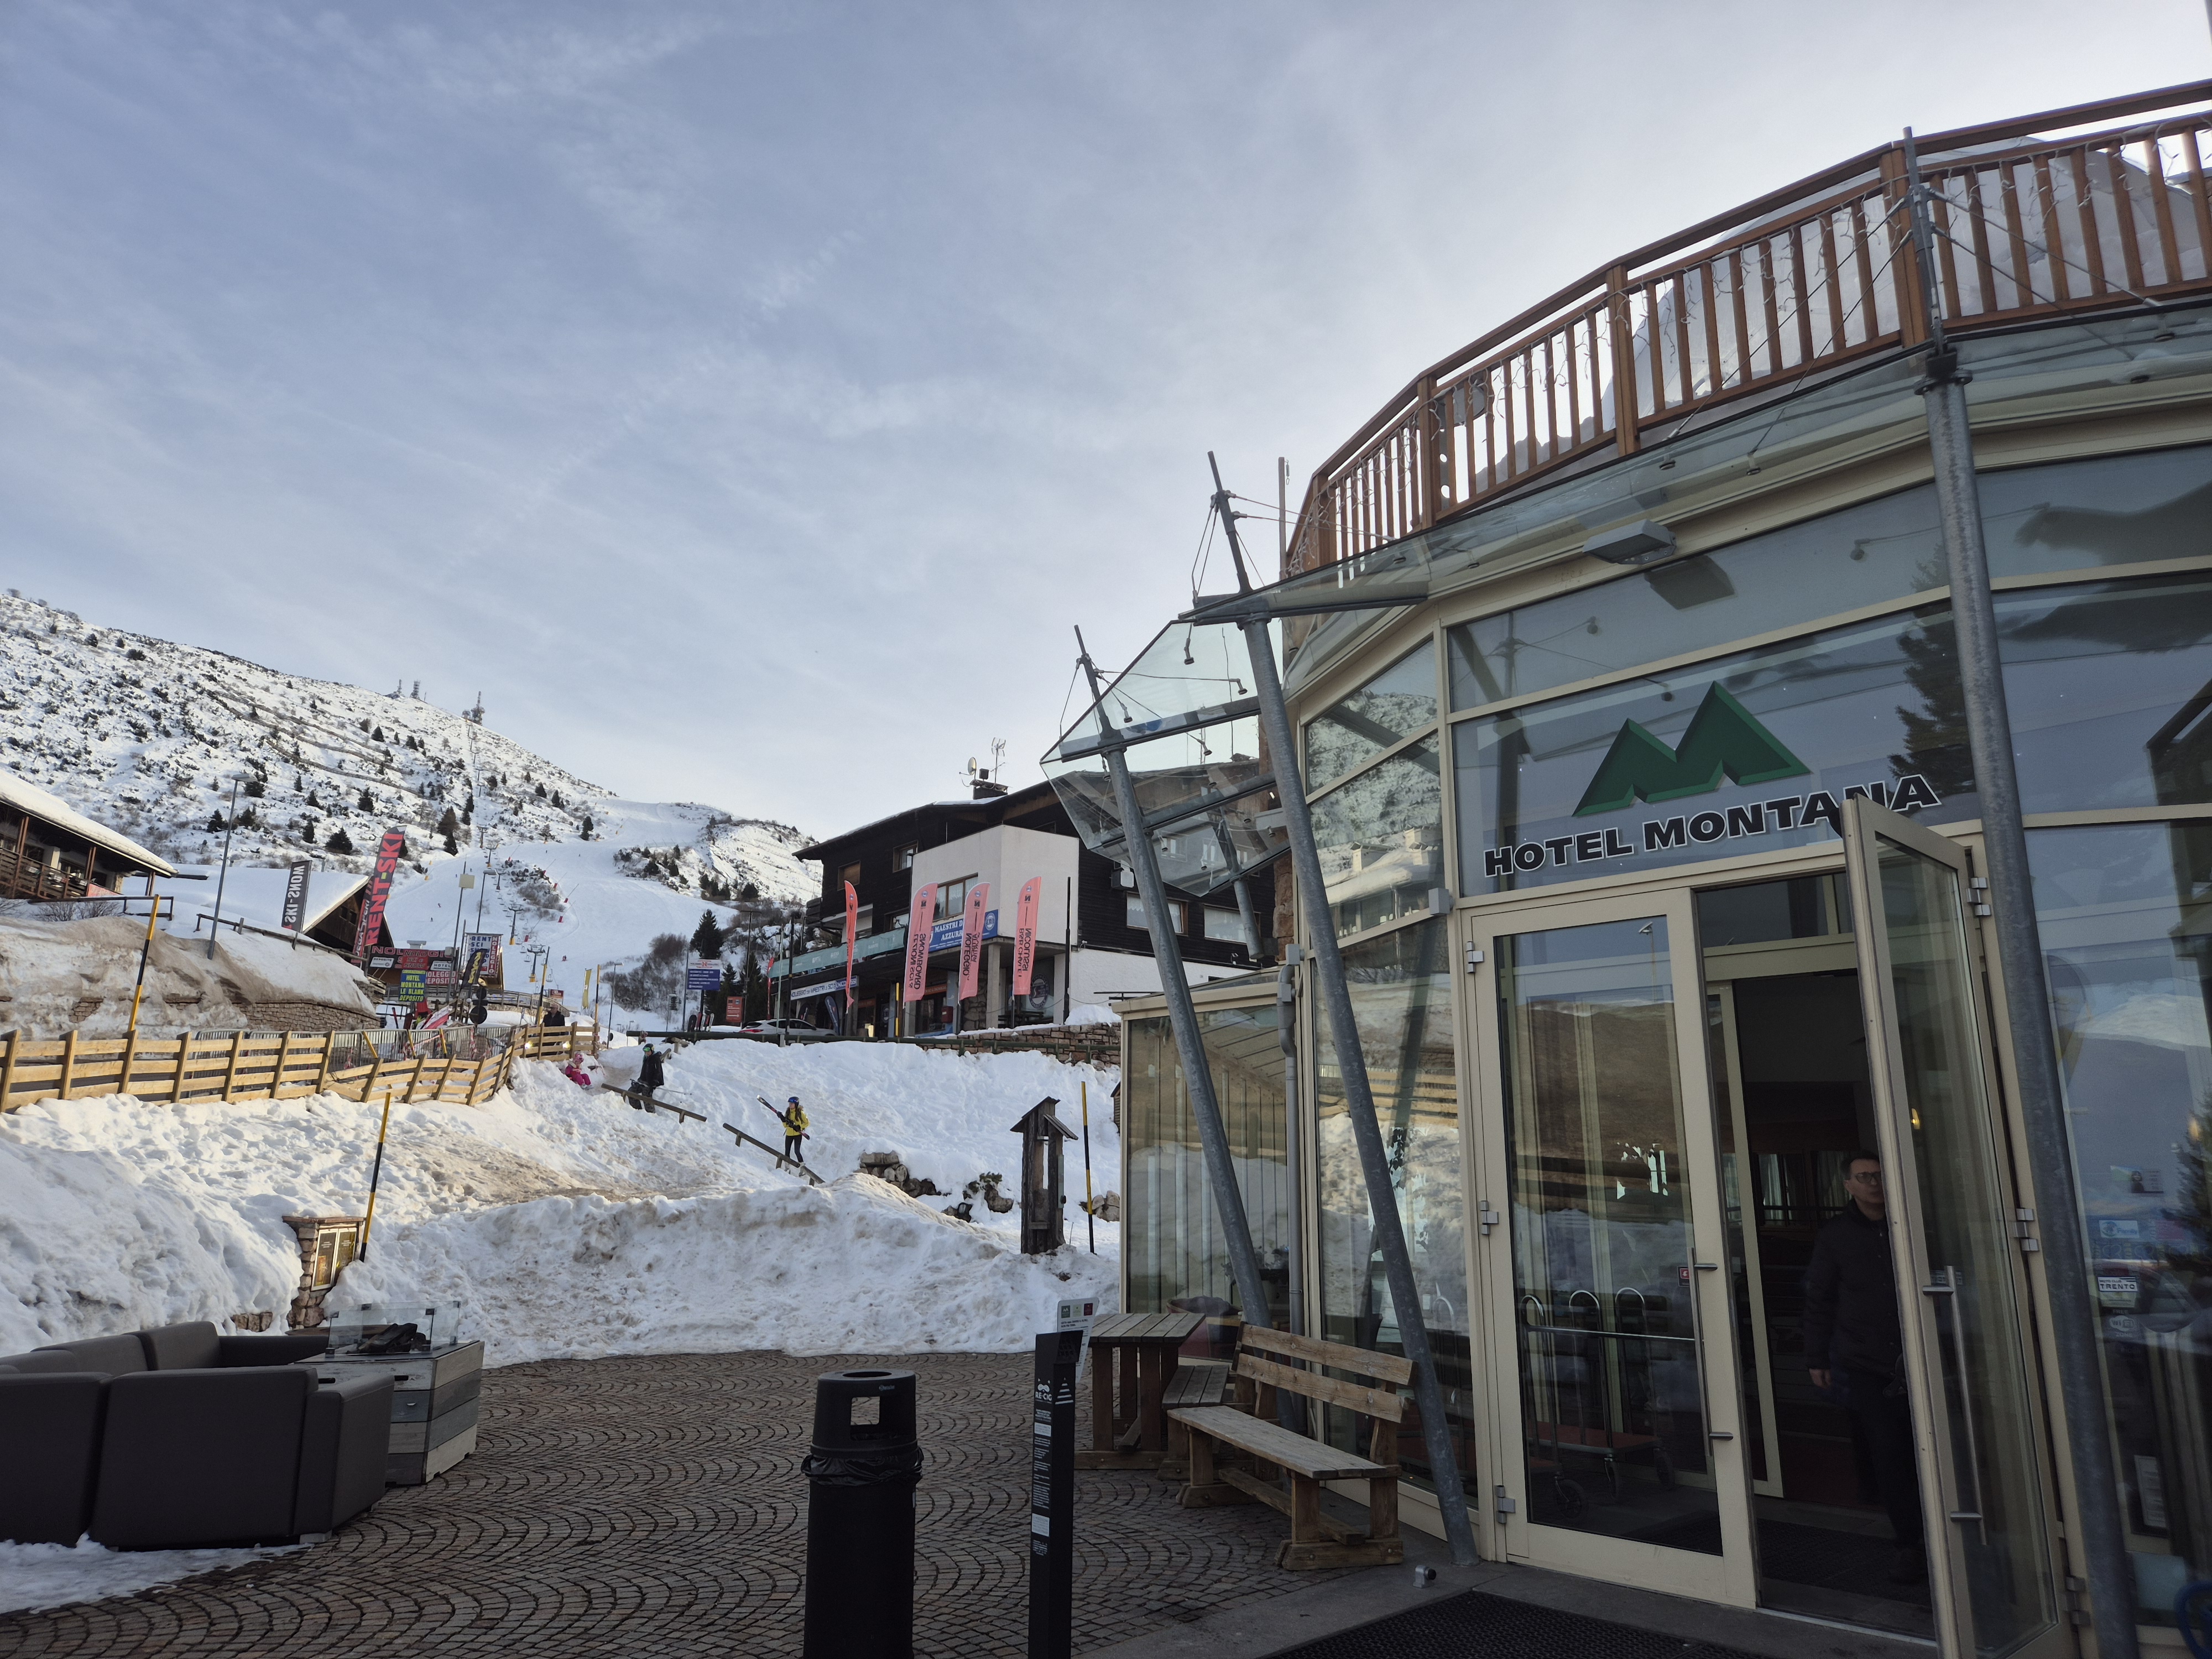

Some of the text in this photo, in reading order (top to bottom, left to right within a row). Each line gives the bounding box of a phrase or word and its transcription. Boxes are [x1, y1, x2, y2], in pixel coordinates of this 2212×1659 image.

[1484, 827, 1634, 877] HOTEL
[366, 833, 404, 945] RENT-SKI
[935, 922, 957, 933] MAESTRI
[941, 930, 964, 941] AZZURR
[488, 937, 498, 973] NOLEGGIO
[838, 978, 857, 987] NICOSSI
